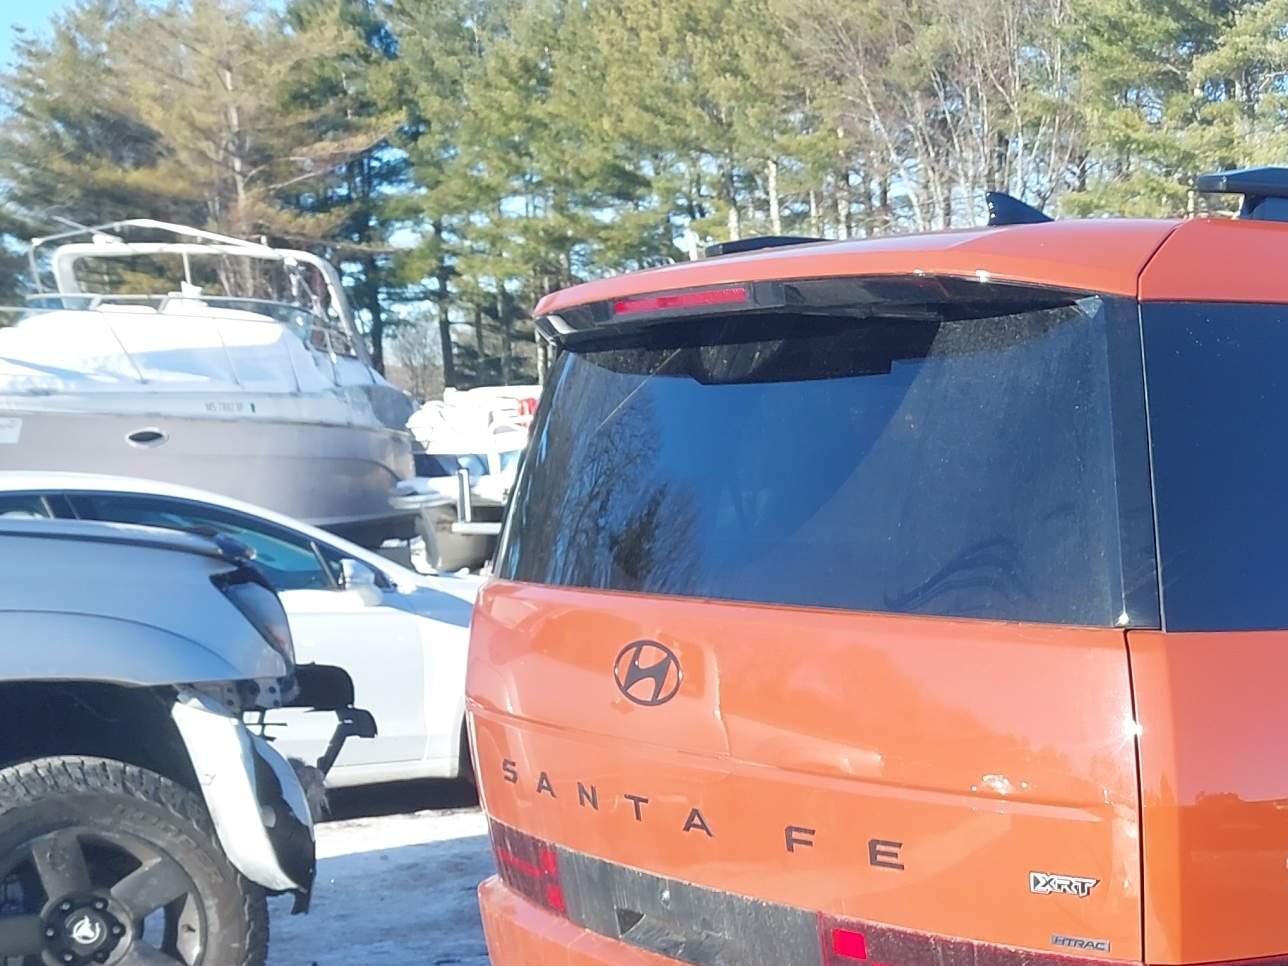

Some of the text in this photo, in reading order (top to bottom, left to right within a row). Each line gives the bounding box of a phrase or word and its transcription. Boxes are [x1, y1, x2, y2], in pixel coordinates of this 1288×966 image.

[502, 760, 904, 870] SANTA FE
[1029, 870, 1101, 898] XRT
